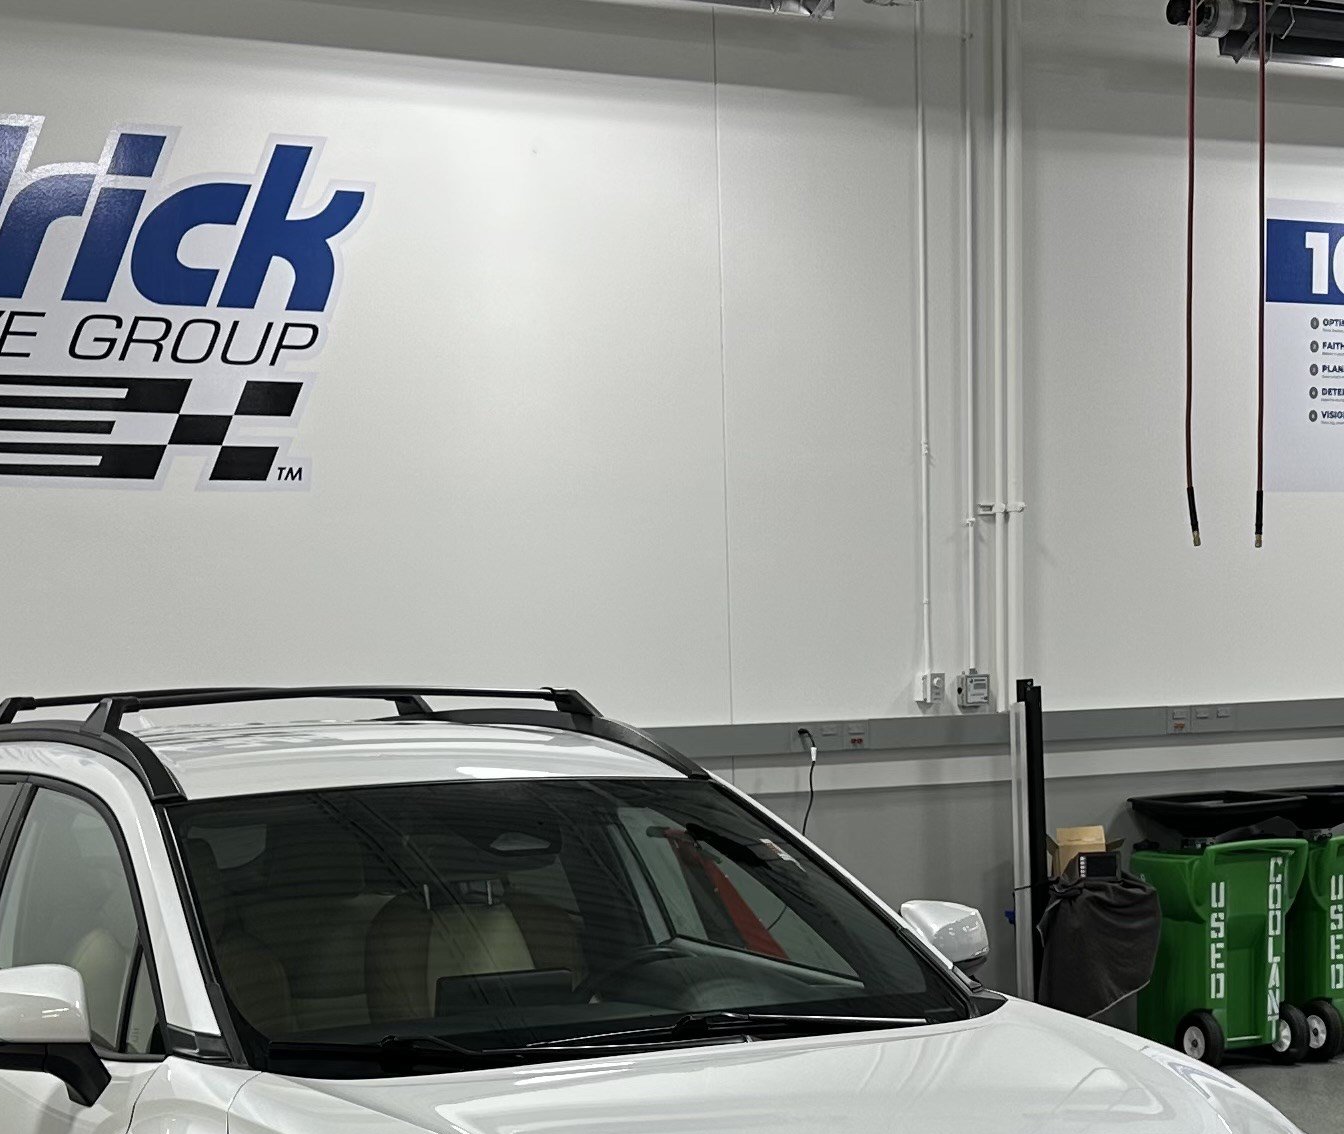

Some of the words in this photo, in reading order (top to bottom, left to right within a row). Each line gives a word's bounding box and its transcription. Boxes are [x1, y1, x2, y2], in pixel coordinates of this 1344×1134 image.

[68, 316, 319, 367] GROUP
[277, 466, 303, 481] TM
[1210, 881, 1225, 999] USED
[1267, 856, 1283, 1041] COOLANT
[1330, 874, 1344, 989] USED
